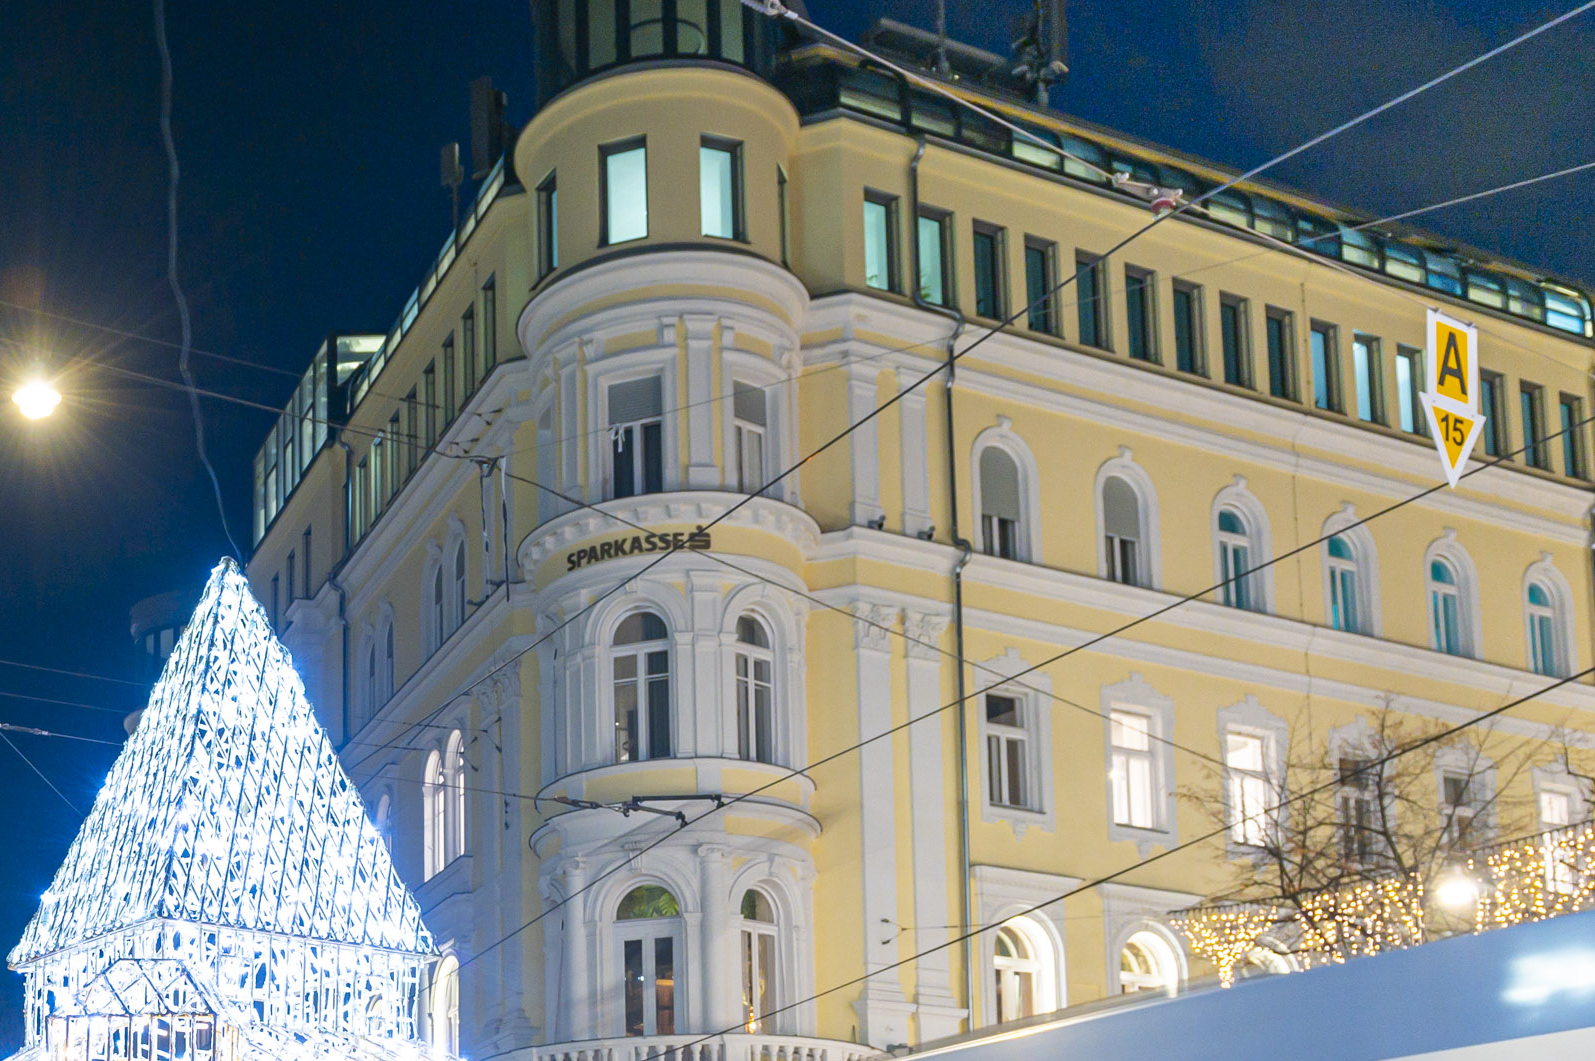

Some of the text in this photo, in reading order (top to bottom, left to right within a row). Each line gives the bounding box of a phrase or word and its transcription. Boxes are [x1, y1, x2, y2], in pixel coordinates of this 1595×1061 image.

[1438, 331, 1467, 395] A
[1441, 414, 1464, 446] 15
[567, 532, 685, 571] SPARKASSE
